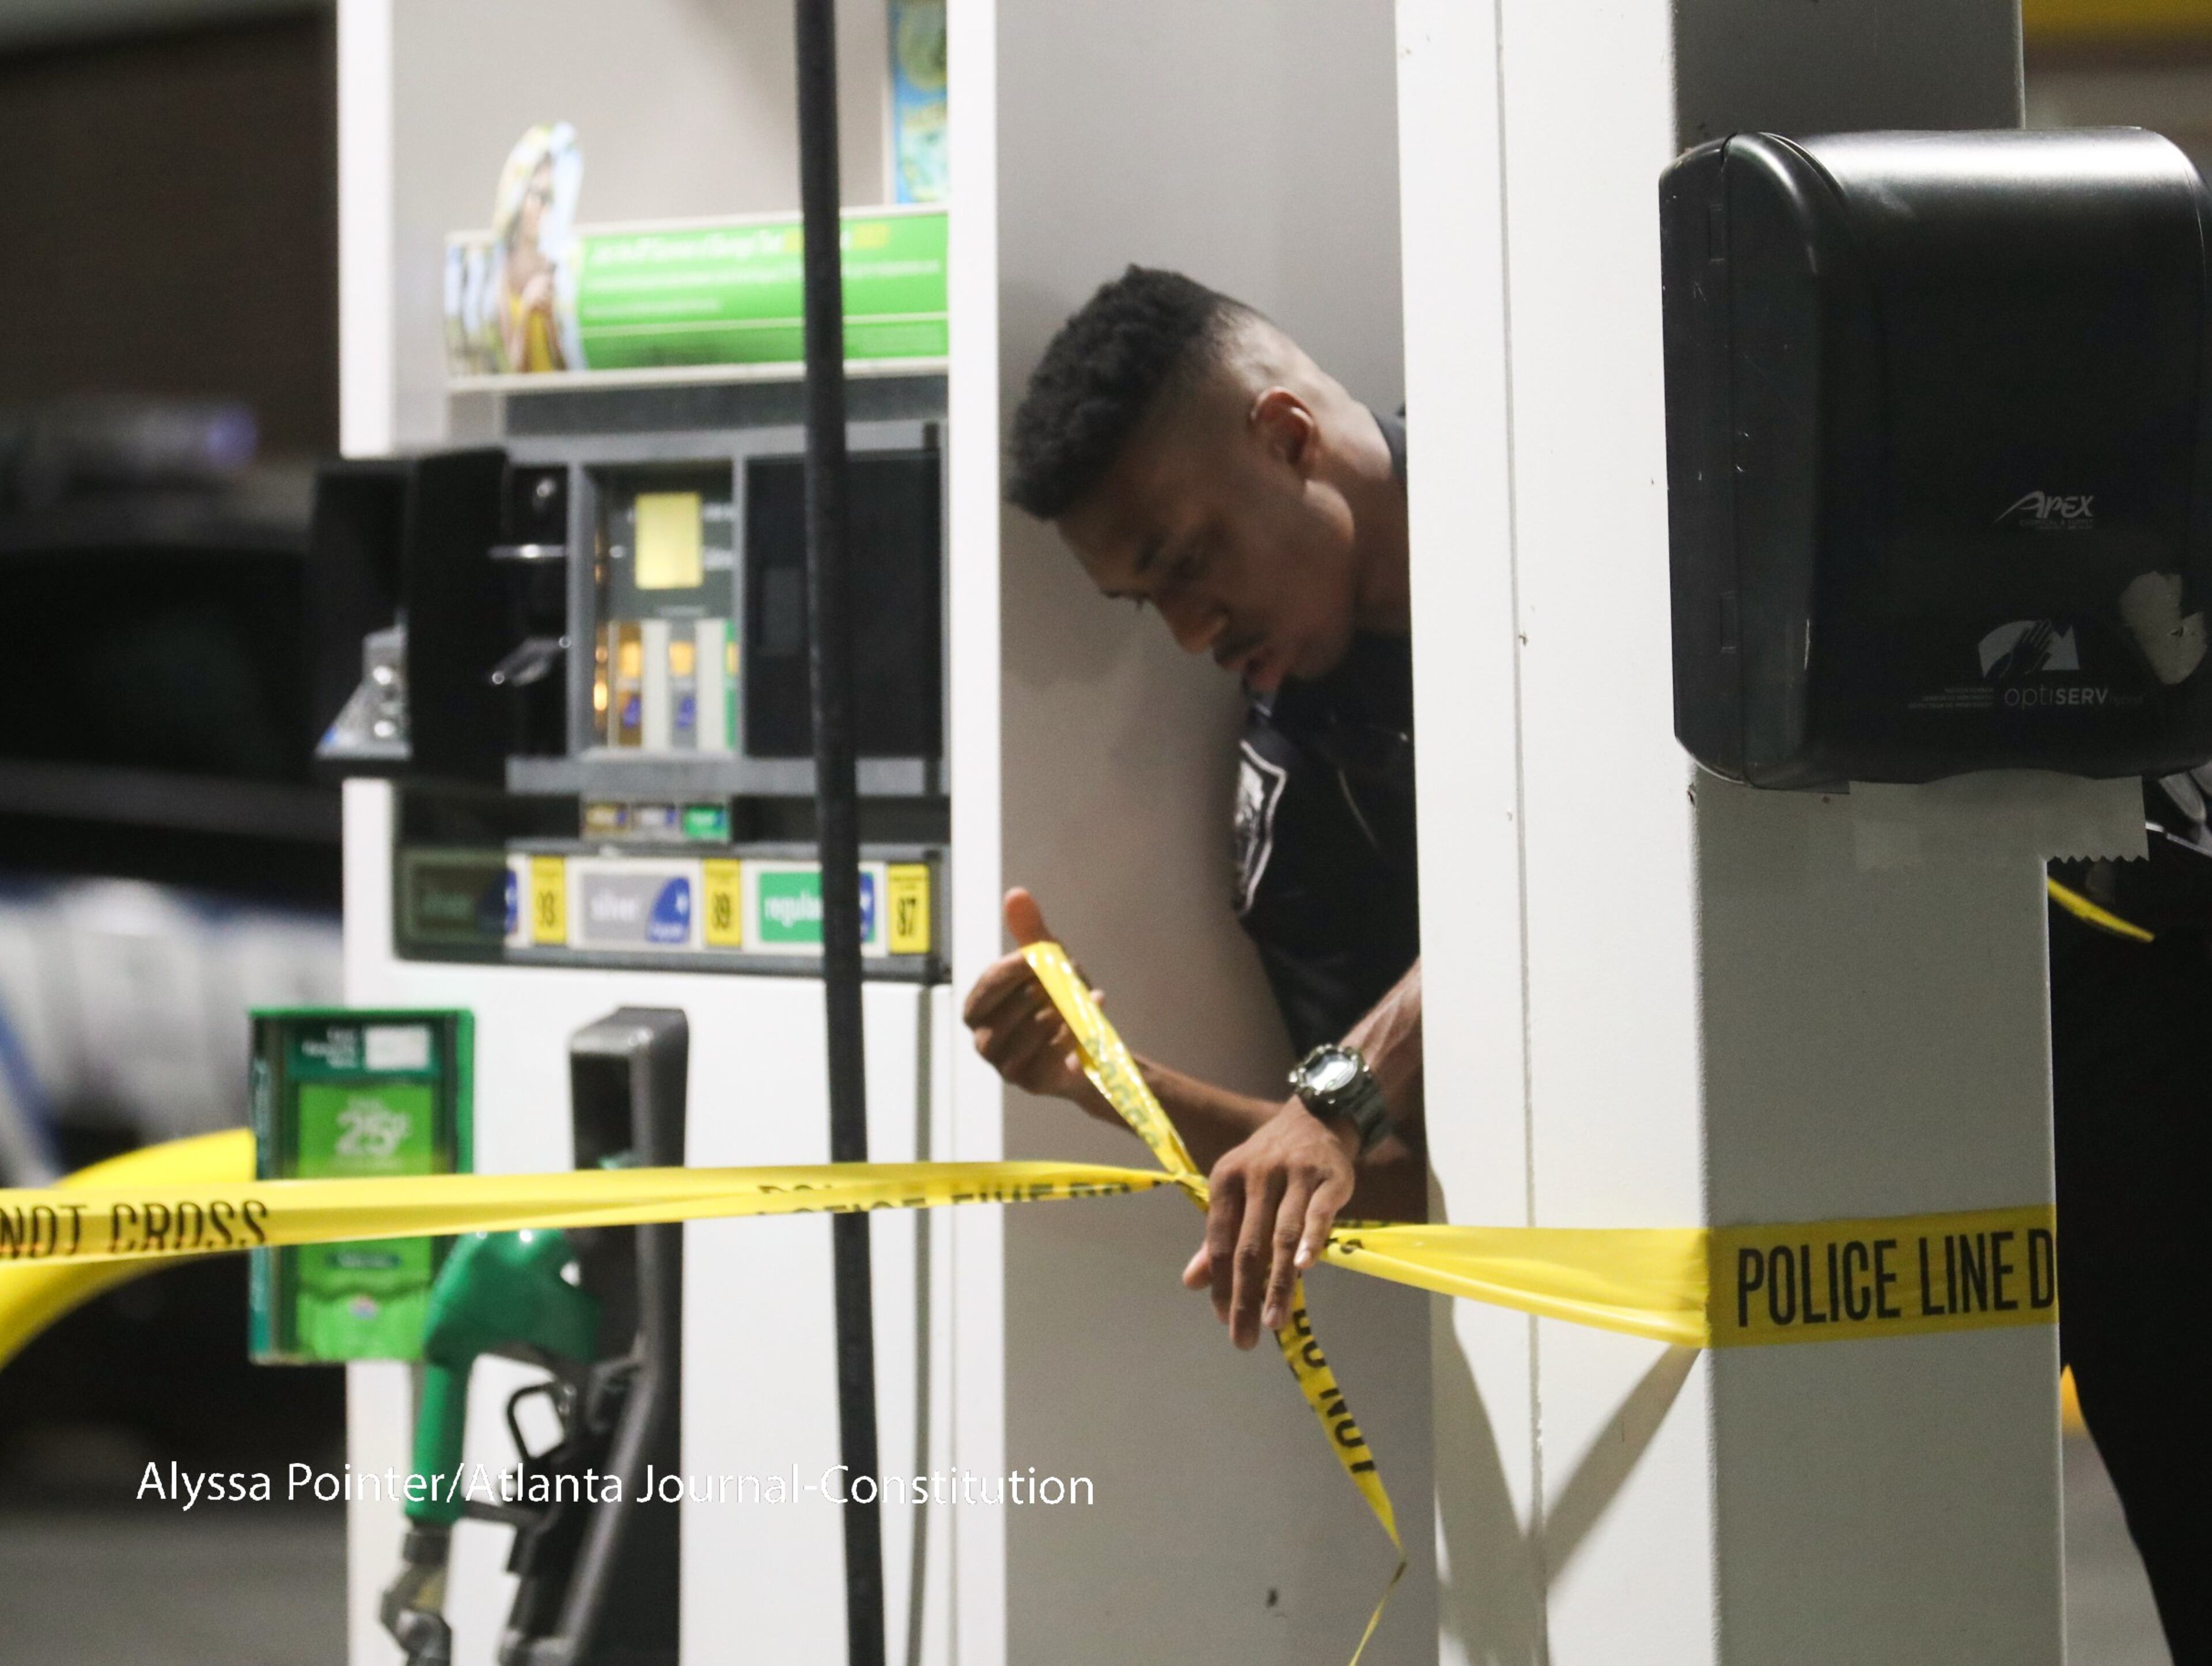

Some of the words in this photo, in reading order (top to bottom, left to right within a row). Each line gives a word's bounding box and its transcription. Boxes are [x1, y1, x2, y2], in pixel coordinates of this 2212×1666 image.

[763, 890, 823, 928] regula
[109, 1199, 268, 1253] CROSS
[1737, 1238, 1901, 1328] POLICE
[1918, 1230, 2019, 1316] LINE
